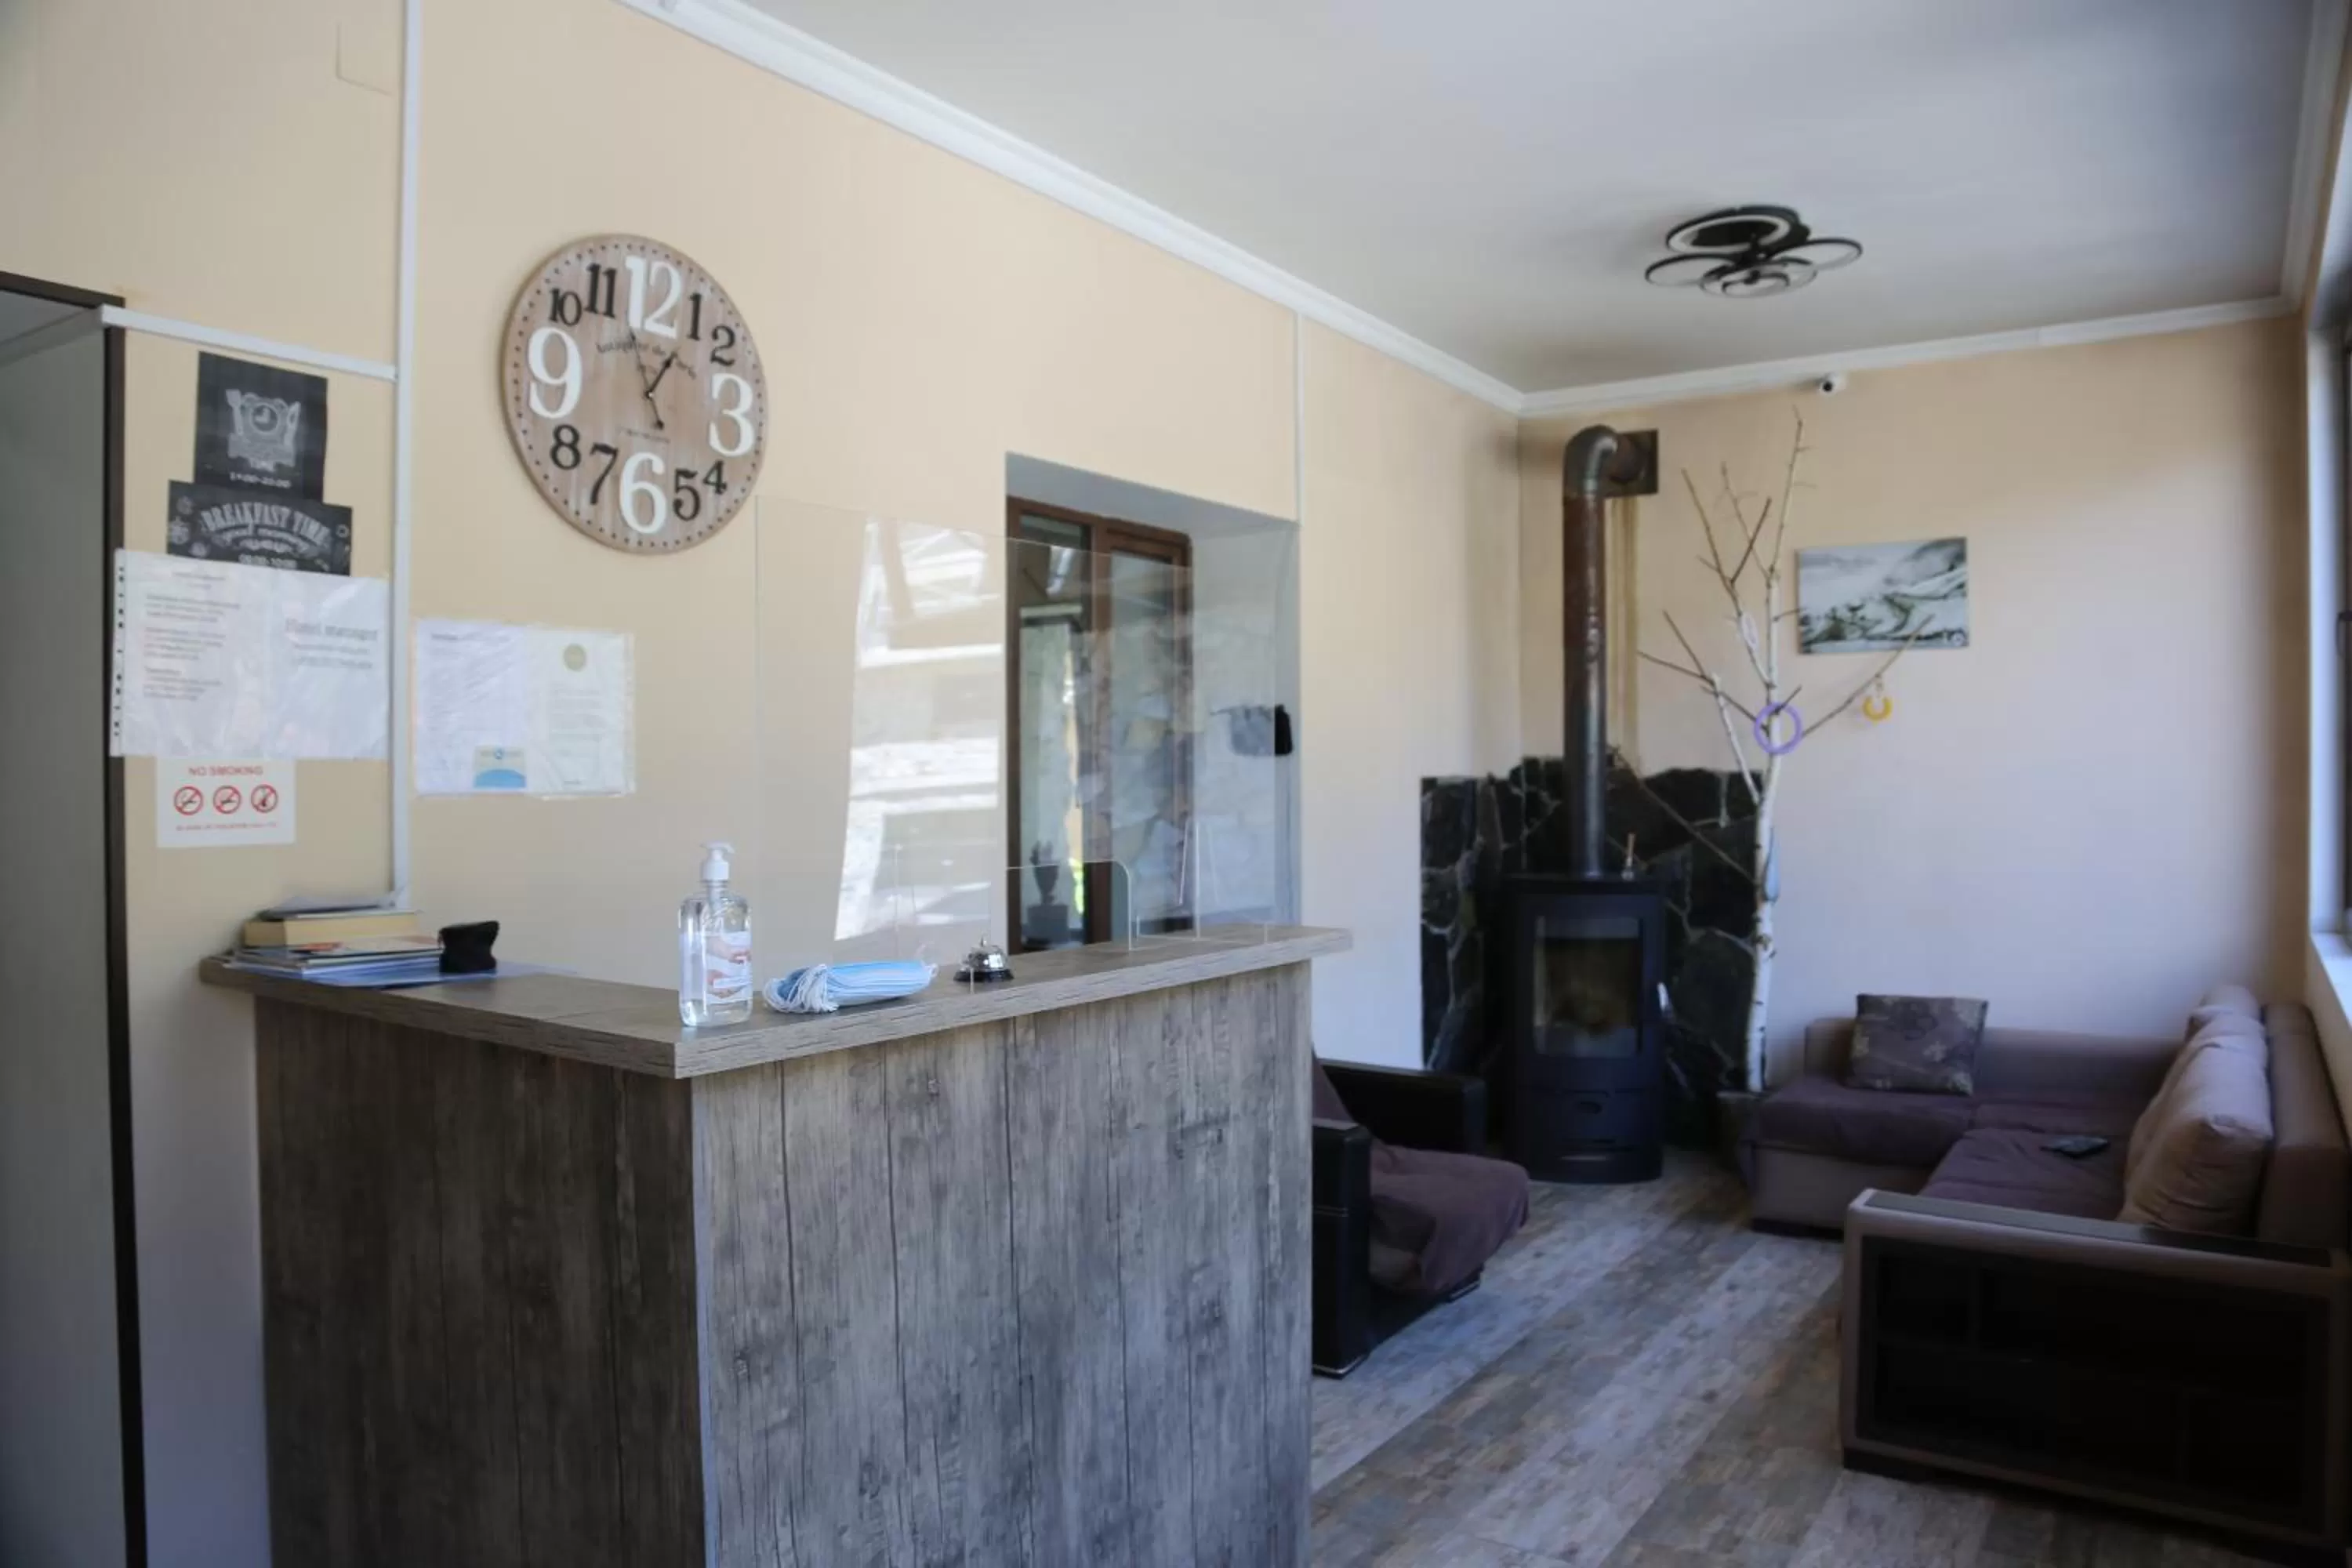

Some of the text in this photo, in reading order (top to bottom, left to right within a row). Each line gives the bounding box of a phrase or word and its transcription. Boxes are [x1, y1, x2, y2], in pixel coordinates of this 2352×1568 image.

[549, 288, 582, 327] 10
[584, 263, 617, 319] 11
[626, 255, 682, 340] 12
[687, 292, 702, 341] 1
[528, 326, 582, 419] 9
[710, 325, 736, 367] 2
[709, 372, 754, 457] 3
[550, 423, 582, 470] 8
[590, 443, 619, 504] 7
[619, 452, 666, 534] 6
[672, 468, 702, 521] 5
[702, 459, 728, 495] 4
